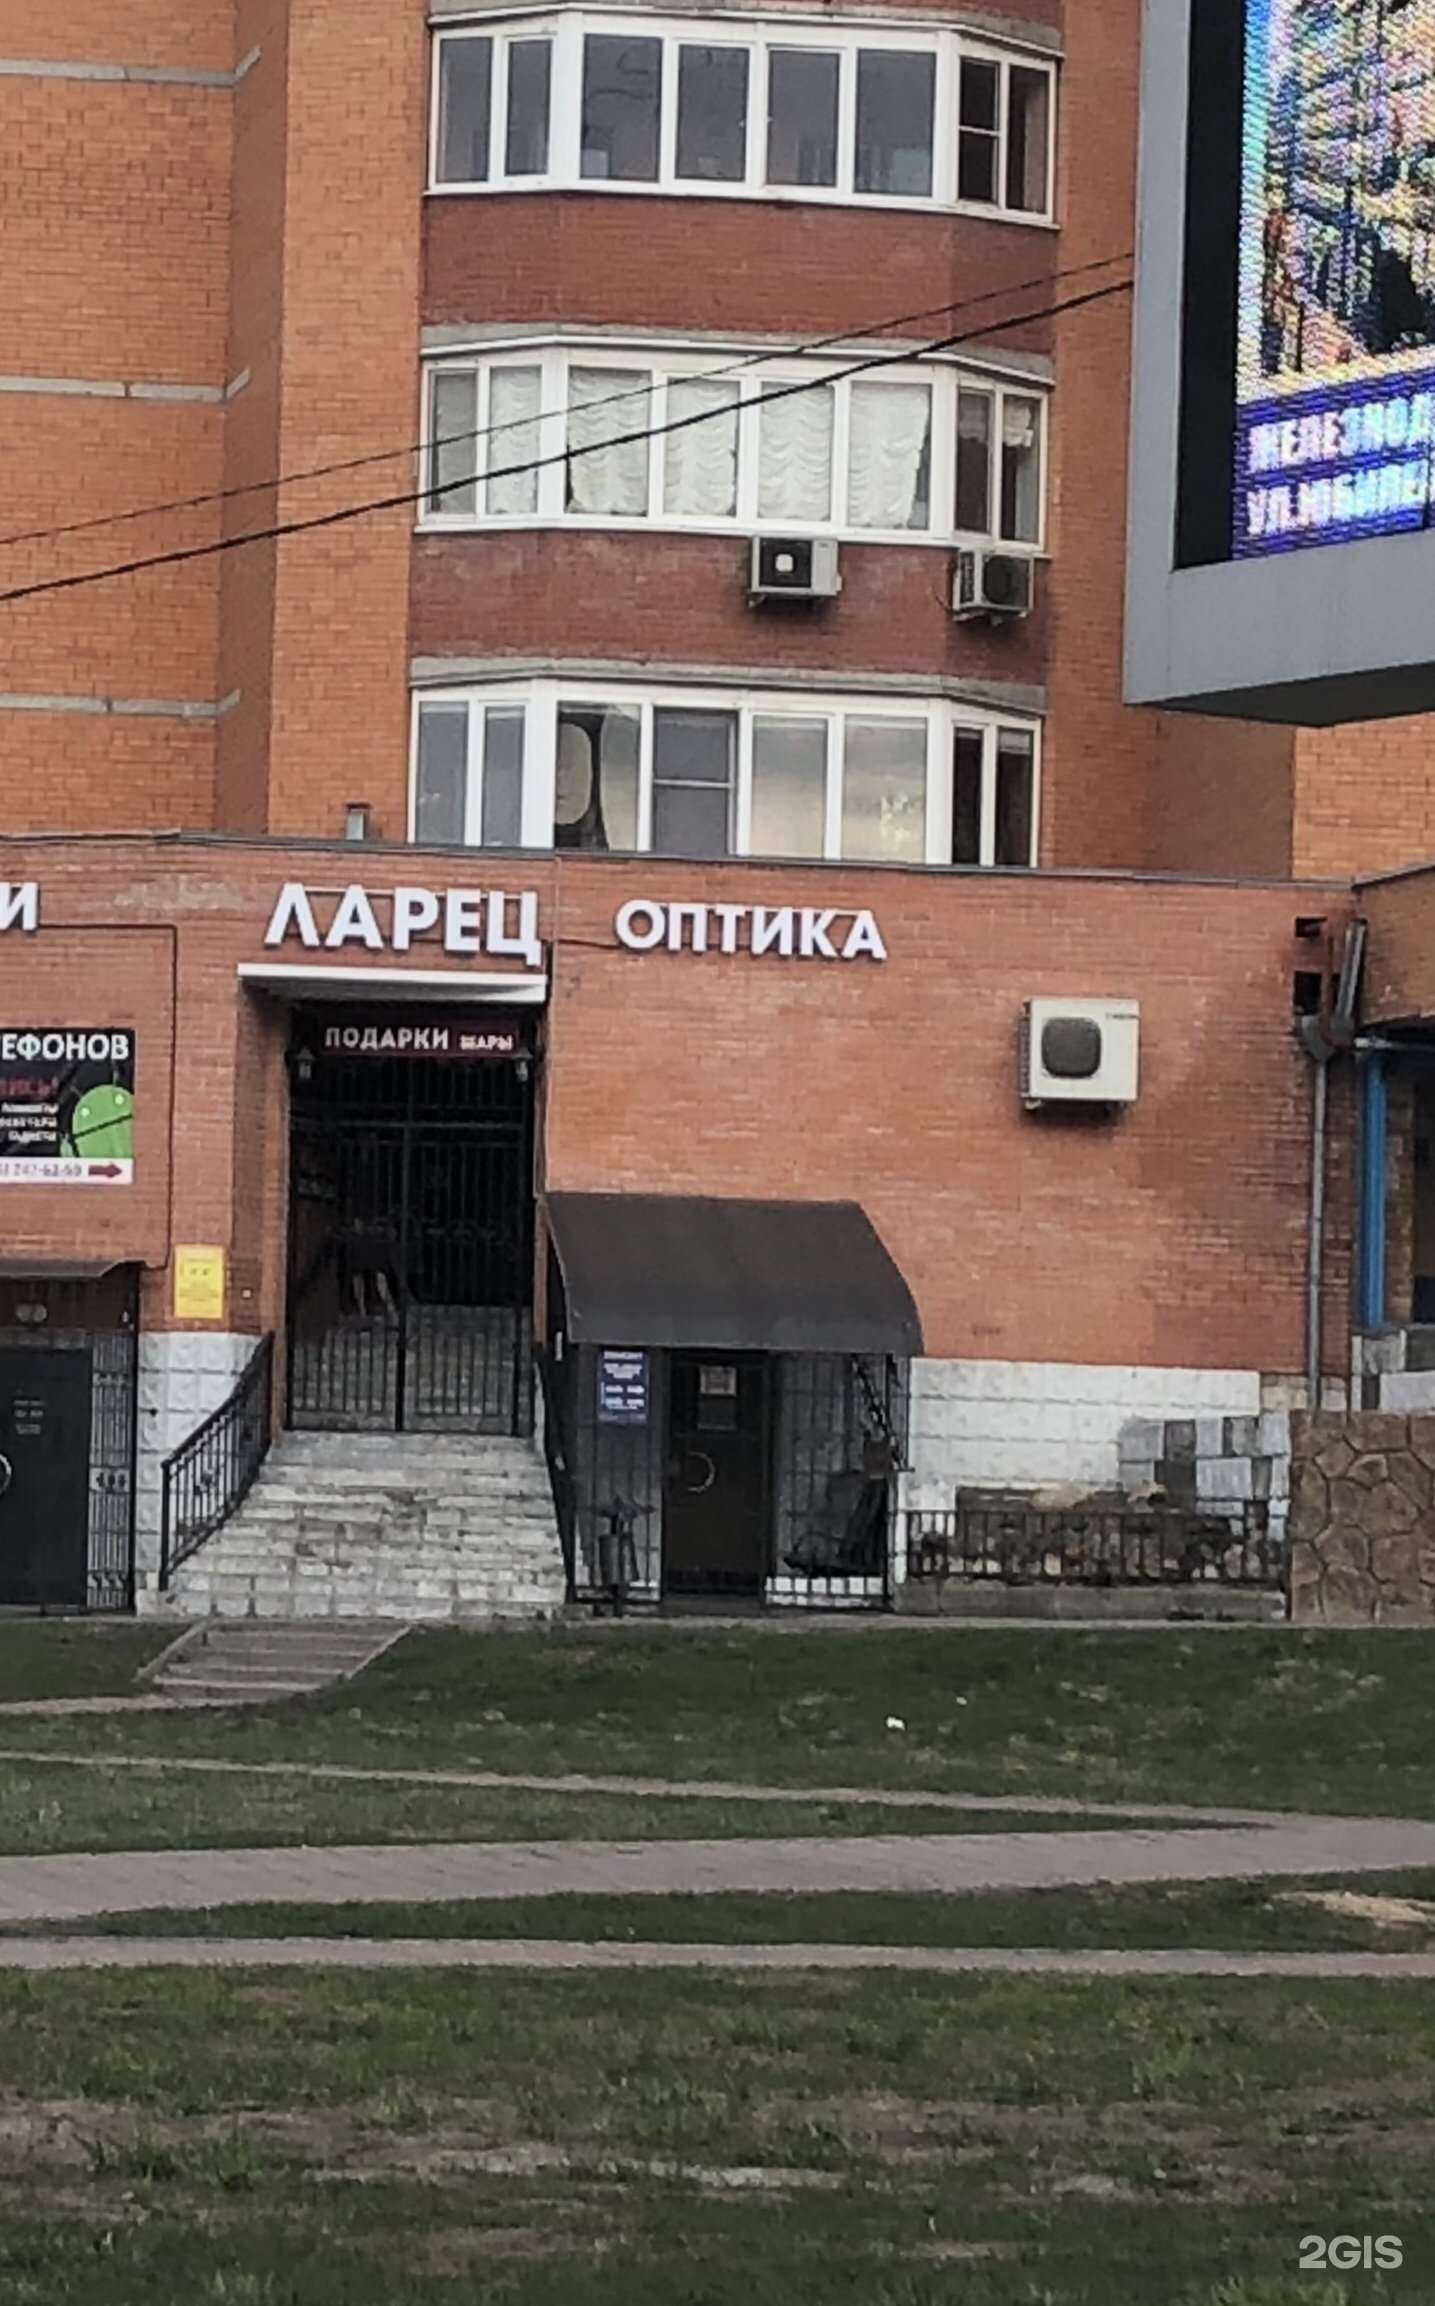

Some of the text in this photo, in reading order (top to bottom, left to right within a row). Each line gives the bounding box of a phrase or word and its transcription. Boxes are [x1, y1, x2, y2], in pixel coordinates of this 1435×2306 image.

[264, 882, 542, 966] ЛАРЕЦ
[615, 899, 888, 960] ОПТИКА
[325, 1027, 513, 1050] ПОДАРКИ ШАРЫ
